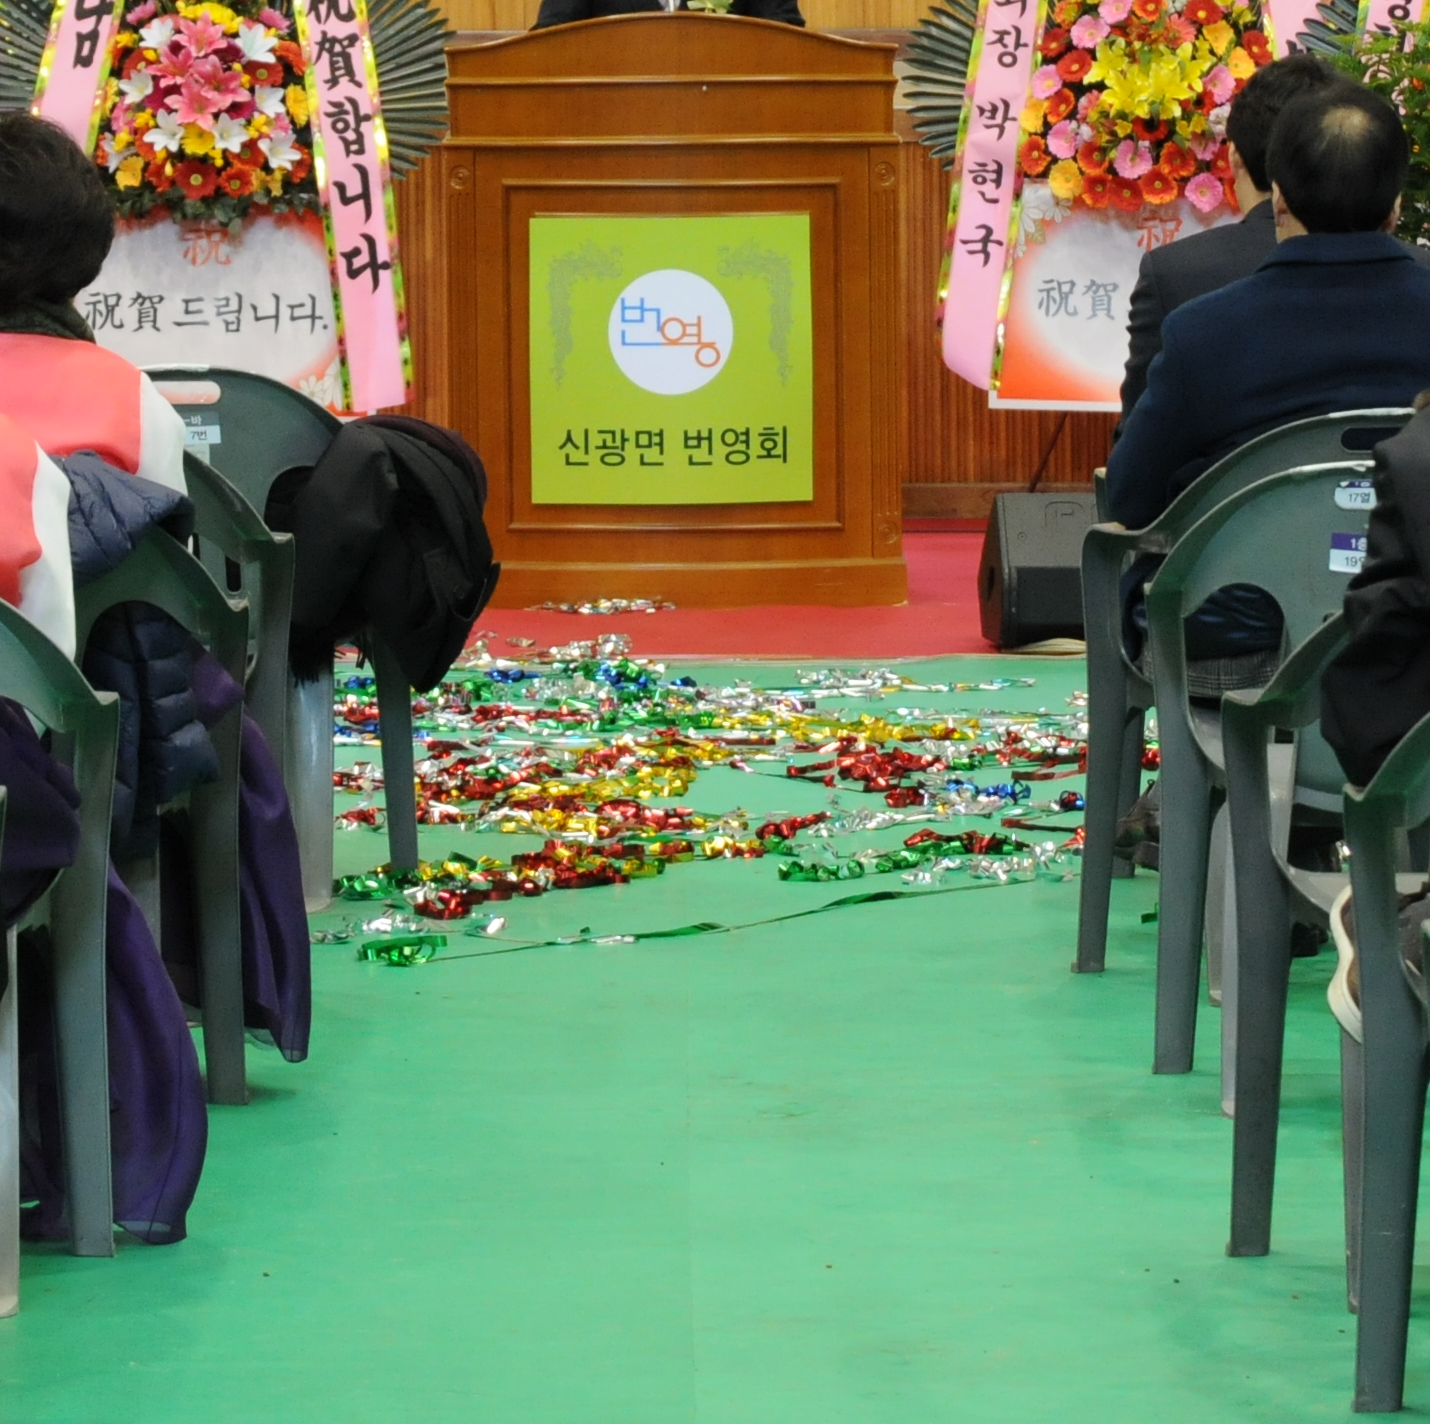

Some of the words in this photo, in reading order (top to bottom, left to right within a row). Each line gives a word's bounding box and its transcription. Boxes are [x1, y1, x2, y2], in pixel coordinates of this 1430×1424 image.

[959, 97, 1018, 268] 박현국
[620, 297, 721, 368] 번영
[558, 427, 665, 468] 신광면
[683, 425, 789, 467] 번영회
